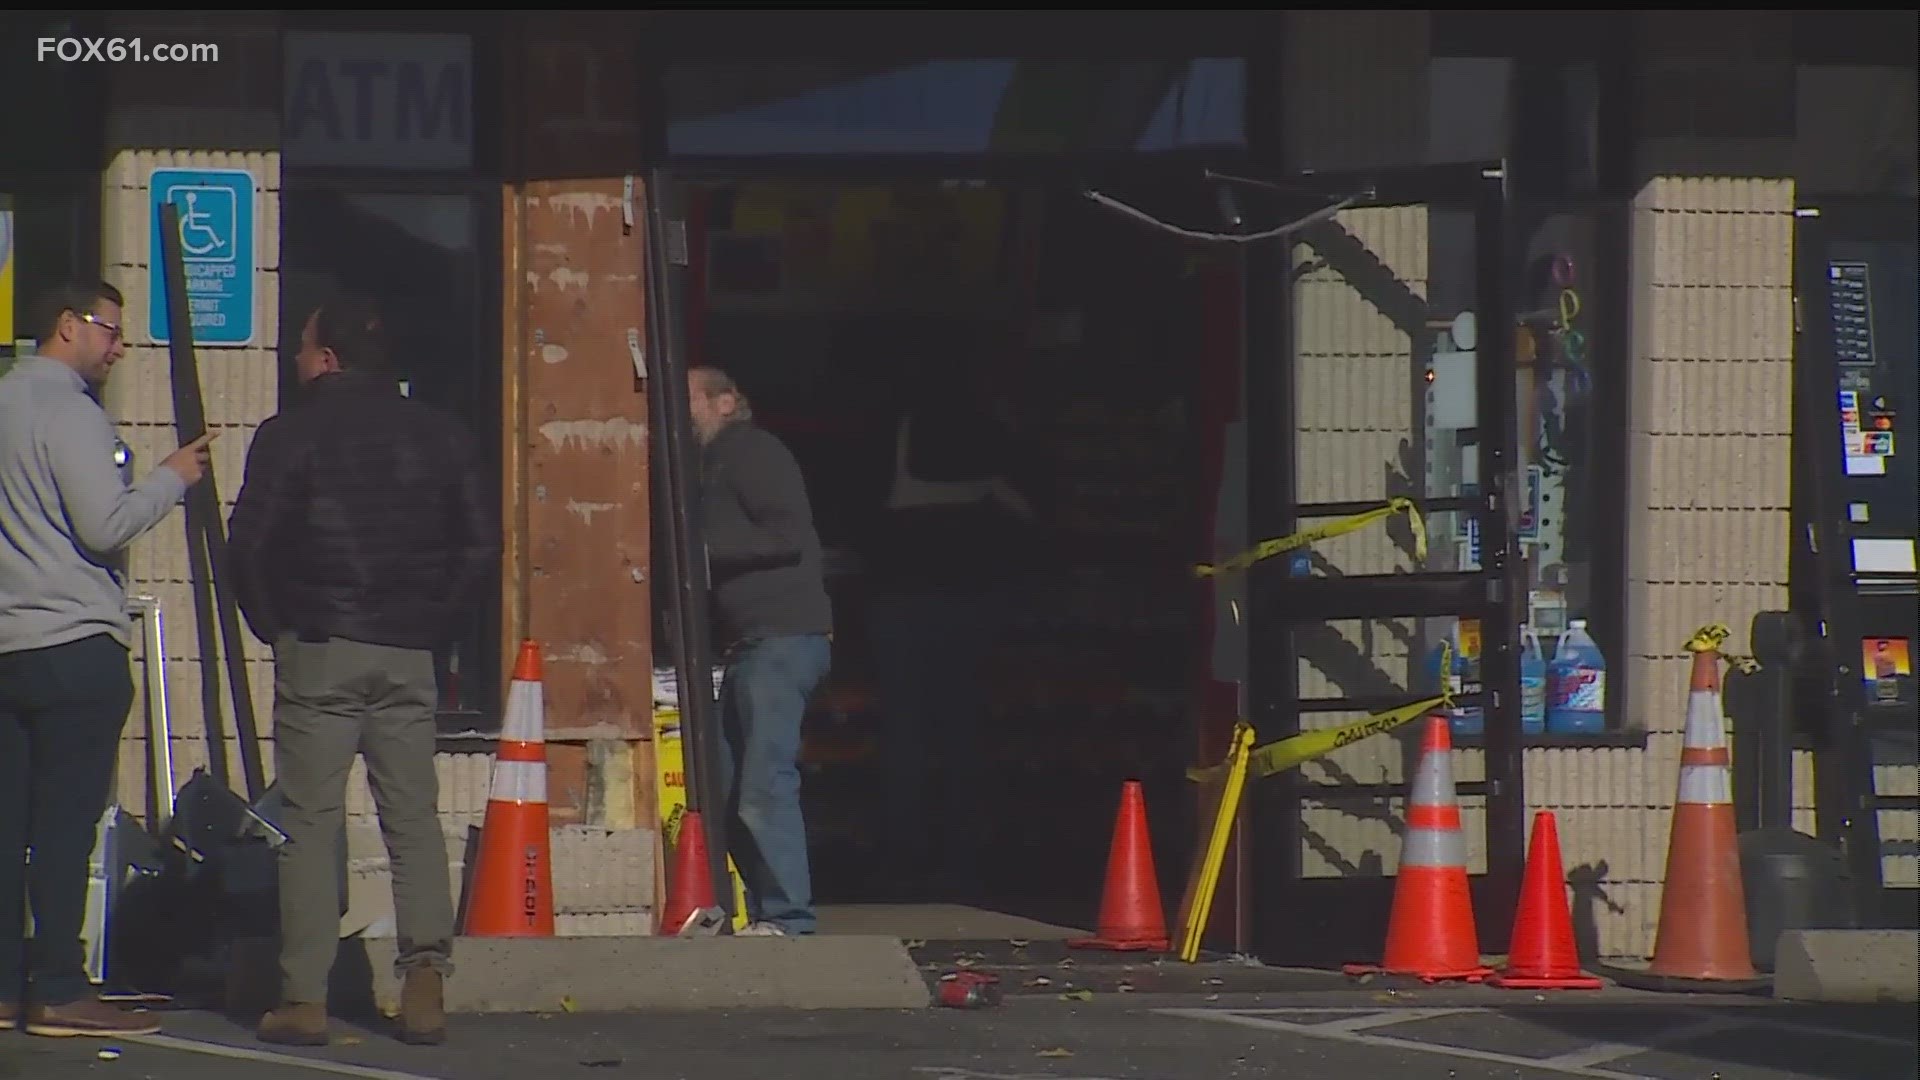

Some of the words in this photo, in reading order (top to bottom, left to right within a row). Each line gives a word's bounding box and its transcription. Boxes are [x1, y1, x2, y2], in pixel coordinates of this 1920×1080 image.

[286, 61, 467, 139] ATM
[186, 279, 223, 292] ARKING
[188, 299, 220, 312] ERMIT
